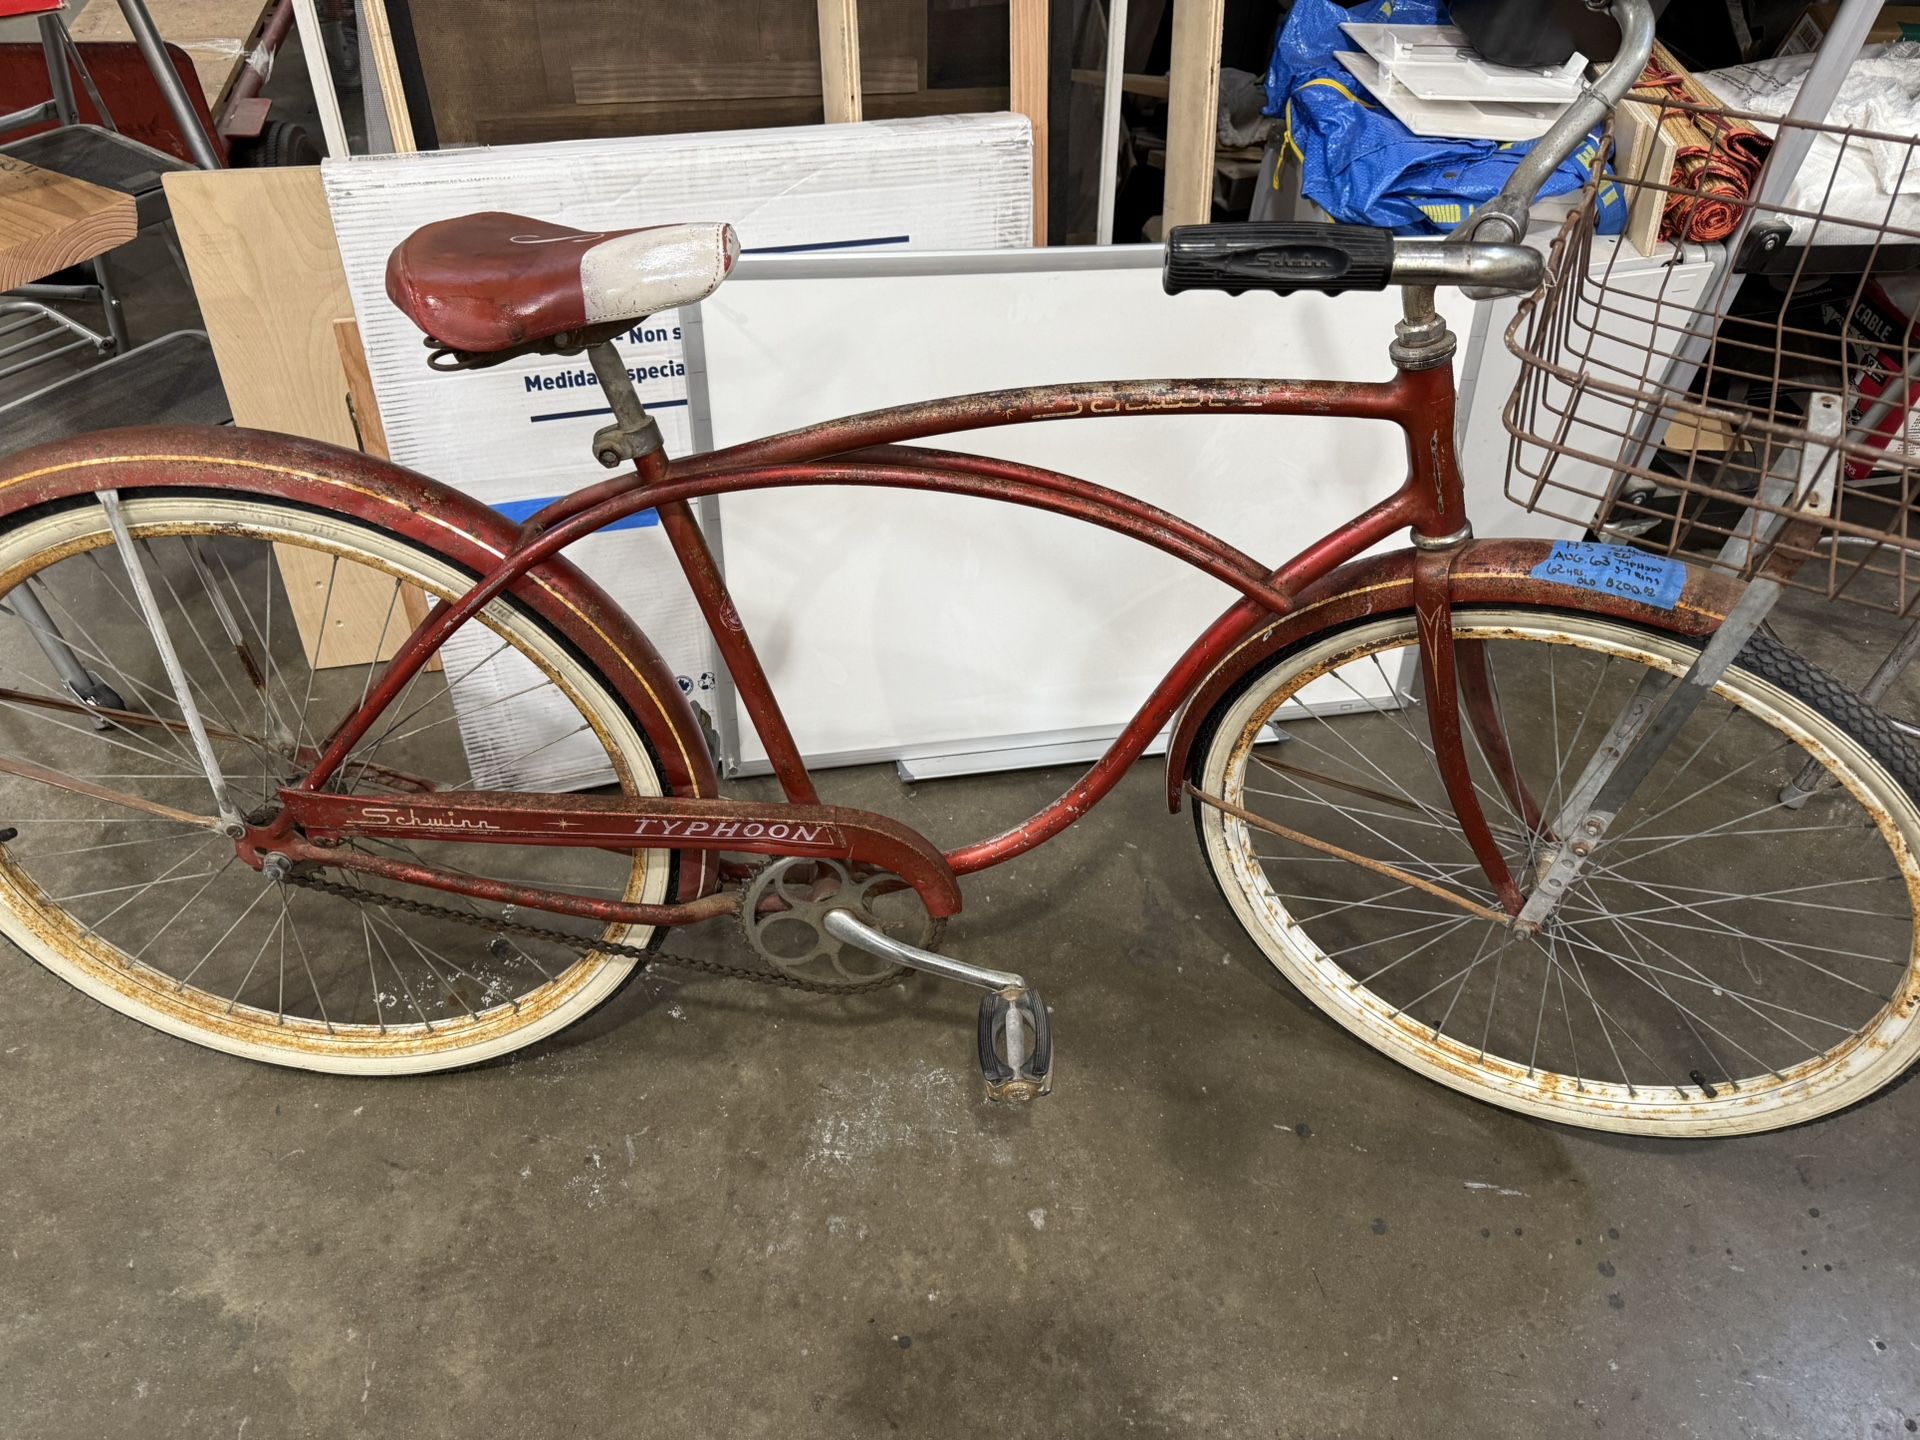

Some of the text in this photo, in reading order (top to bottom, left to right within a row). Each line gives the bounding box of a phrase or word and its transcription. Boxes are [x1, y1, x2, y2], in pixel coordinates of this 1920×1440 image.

[1244, 252, 1333, 268] Schwinn
[1854, 303, 1893, 342] CABLE
[629, 326, 668, 344] Non
[672, 327, 682, 340] s
[524, 360, 685, 392] Medida specia
[346, 808, 500, 829] Schwinn
[634, 819, 823, 842] TYPHOON
